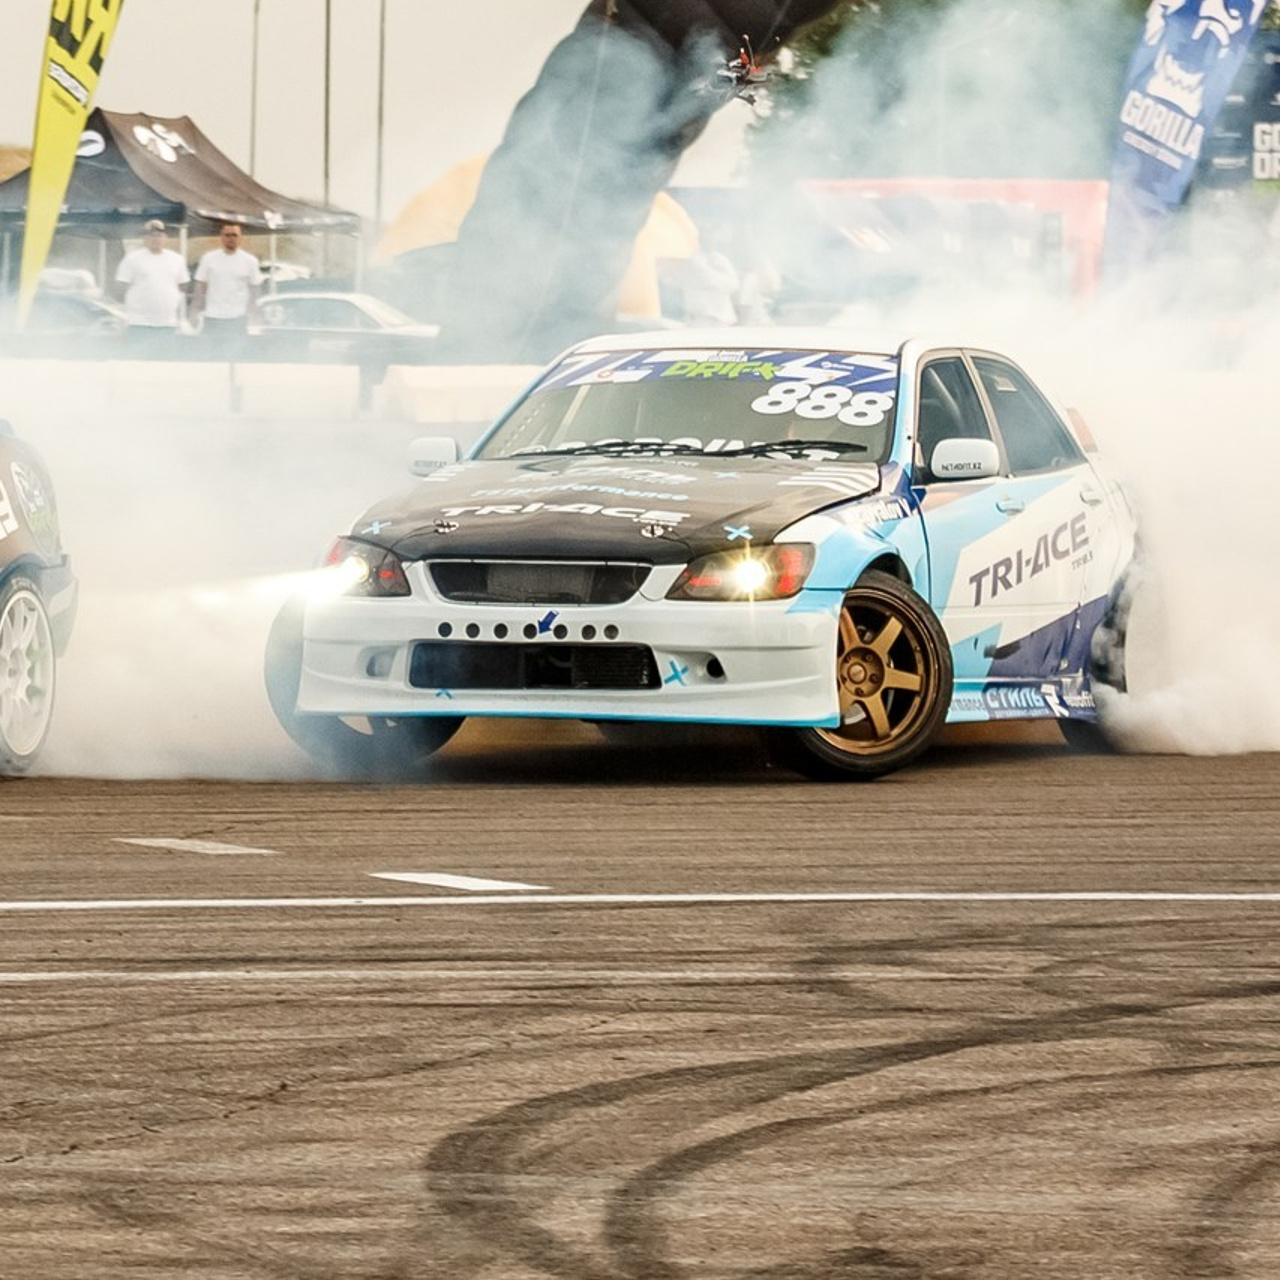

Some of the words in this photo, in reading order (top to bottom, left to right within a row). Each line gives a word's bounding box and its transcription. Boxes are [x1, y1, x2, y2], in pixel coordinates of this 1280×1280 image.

[1120, 90, 1204, 160] GORILLA
[750, 381, 894, 427] 888
[968, 511, 1090, 608] TRI-ACE
[986, 687, 1046, 709] СТИЛЬ
